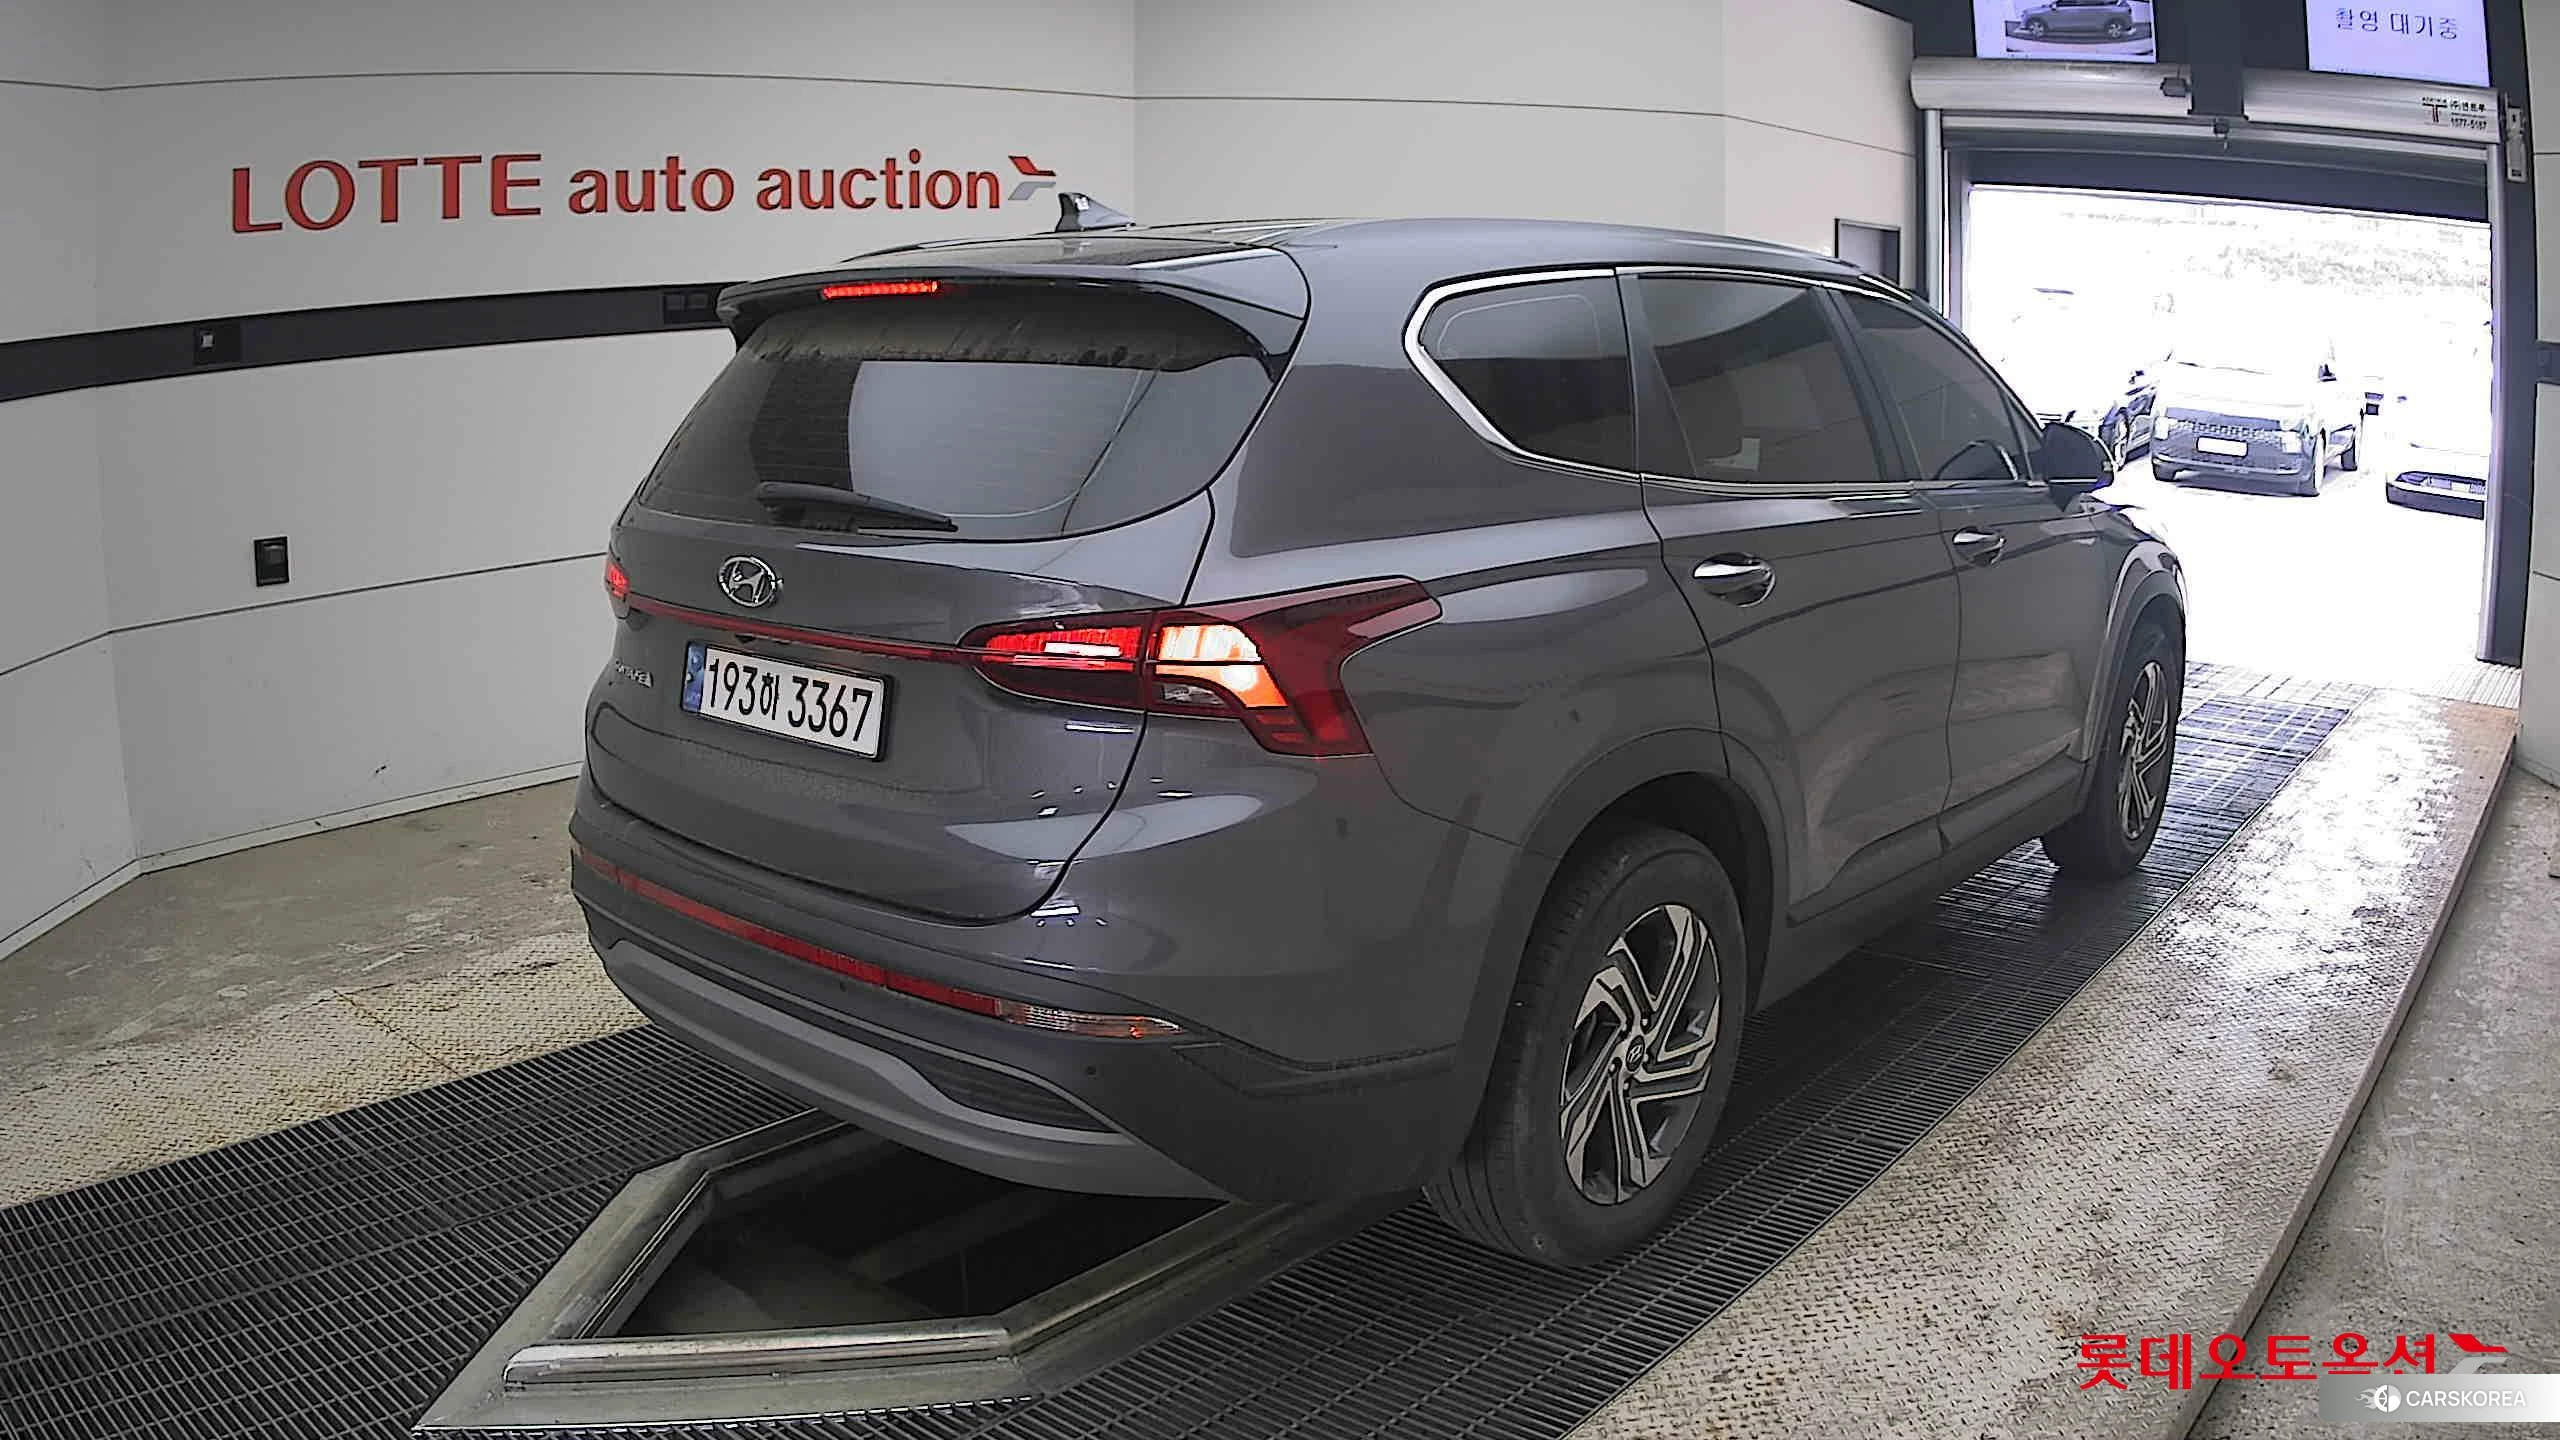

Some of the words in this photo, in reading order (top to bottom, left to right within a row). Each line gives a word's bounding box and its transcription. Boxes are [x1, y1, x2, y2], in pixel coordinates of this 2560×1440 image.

[2335, 7, 2379, 32] 촬영
[2390, 12, 2458, 40] 대기중
[232, 153, 542, 234] LOTTE
[568, 155, 736, 214] auto
[756, 149, 1001, 212] auction
[708, 657, 780, 721] 193하
[787, 675, 873, 742] 3367
